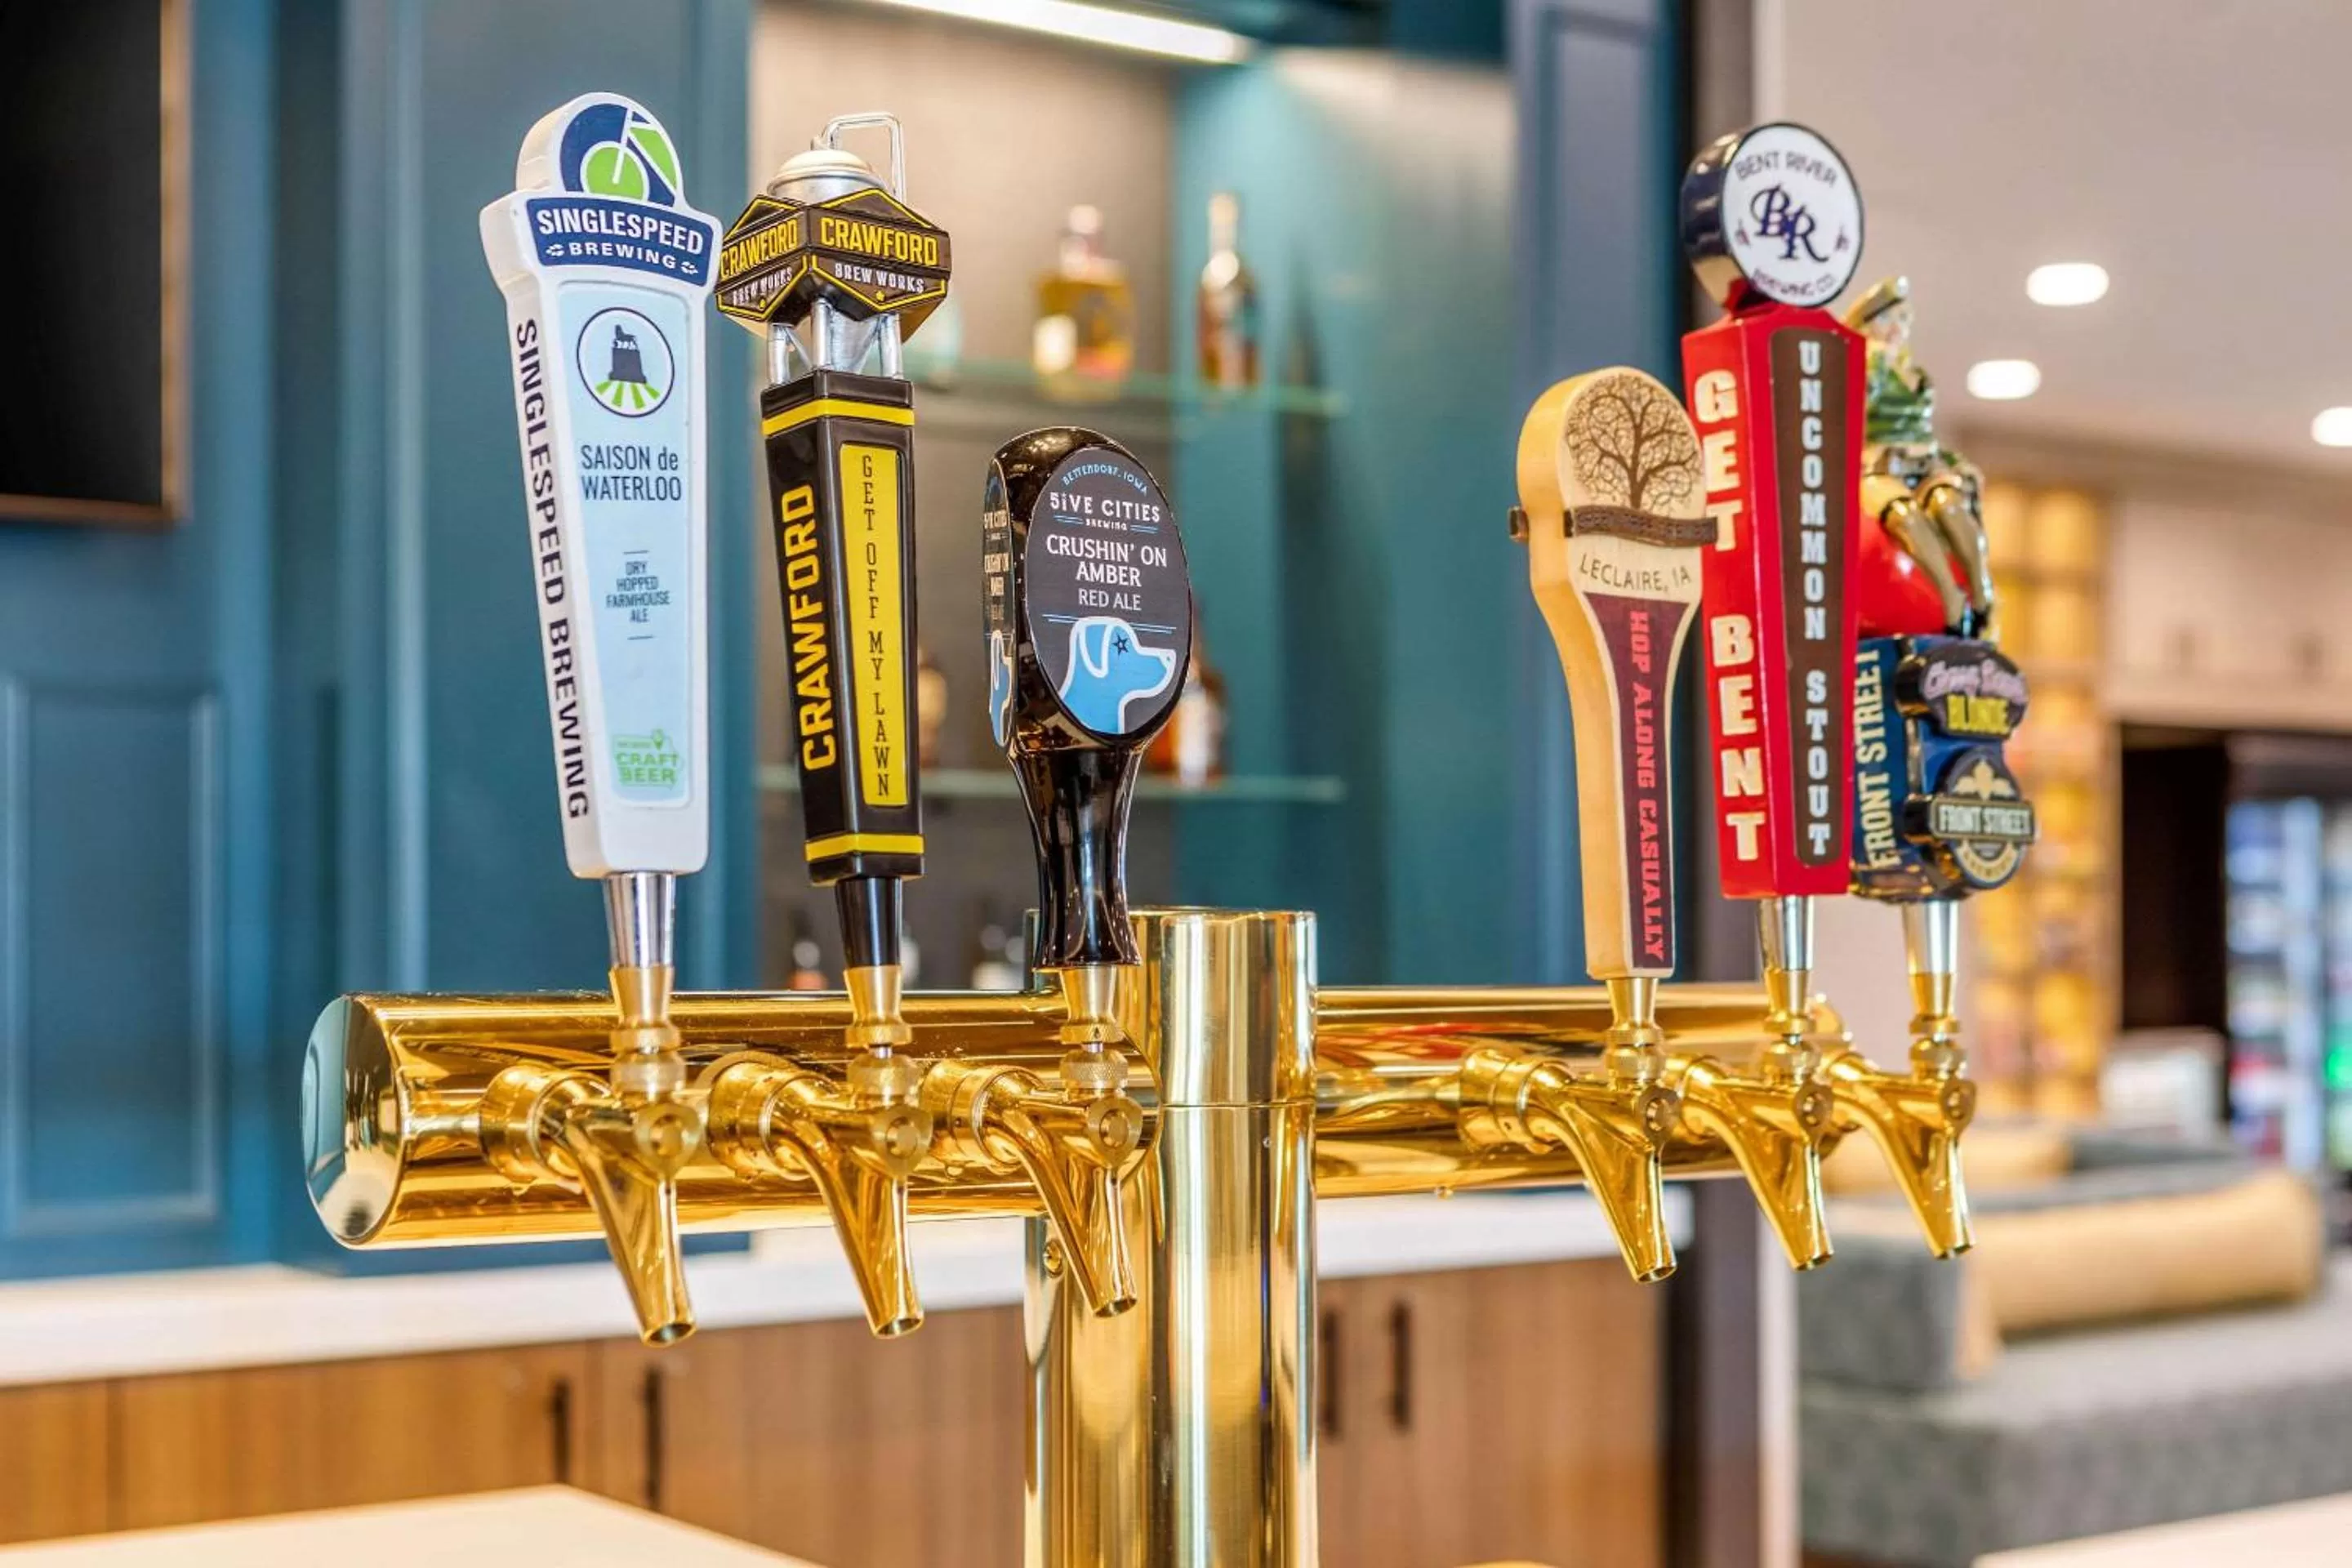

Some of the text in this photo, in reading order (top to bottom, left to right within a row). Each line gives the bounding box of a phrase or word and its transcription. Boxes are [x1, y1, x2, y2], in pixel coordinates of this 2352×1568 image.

[1734, 151, 1838, 188] BENT RIVER
[536, 207, 704, 255] SINGLESPEED
[820, 216, 938, 266] CRAWFORD
[570, 242, 676, 270] BREWING
[720, 219, 798, 279] CRAWFORD
[835, 263, 925, 293] BREW WORKS
[581, 445, 678, 471] SAISON de
[581, 476, 682, 501] WATERLOO
[1123, 471, 1147, 496] IOWA
[1085, 519, 1127, 531] BREWING
[1102, 499, 1160, 523] CITIES
[1046, 534, 1167, 567] CRUSHIN' ON
[516, 318, 590, 818] SINGLESPEED BREWING
[626, 561, 648, 575] DRY
[1076, 561, 1142, 587] AMBER
[1579, 555, 1690, 592] LECLAIRE, IA
[616, 577, 658, 591] HOPPED
[1798, 340, 1830, 856] UNCOMMON STOUT
[606, 590, 670, 608] FARMHOUSE
[1078, 588, 1142, 611] RED ALE
[630, 608, 649, 622] ALE
[782, 484, 836, 770] CRAWFORD
[862, 455, 890, 796] GET OFF MY LAWN
[1694, 370, 1765, 861] GET BENT
[615, 752, 679, 766] CRAFT
[1854, 649, 1902, 868] FRONT STREET
[618, 766, 676, 784] BEER
[1630, 610, 1665, 962] HOP ALONG CASUALLY
